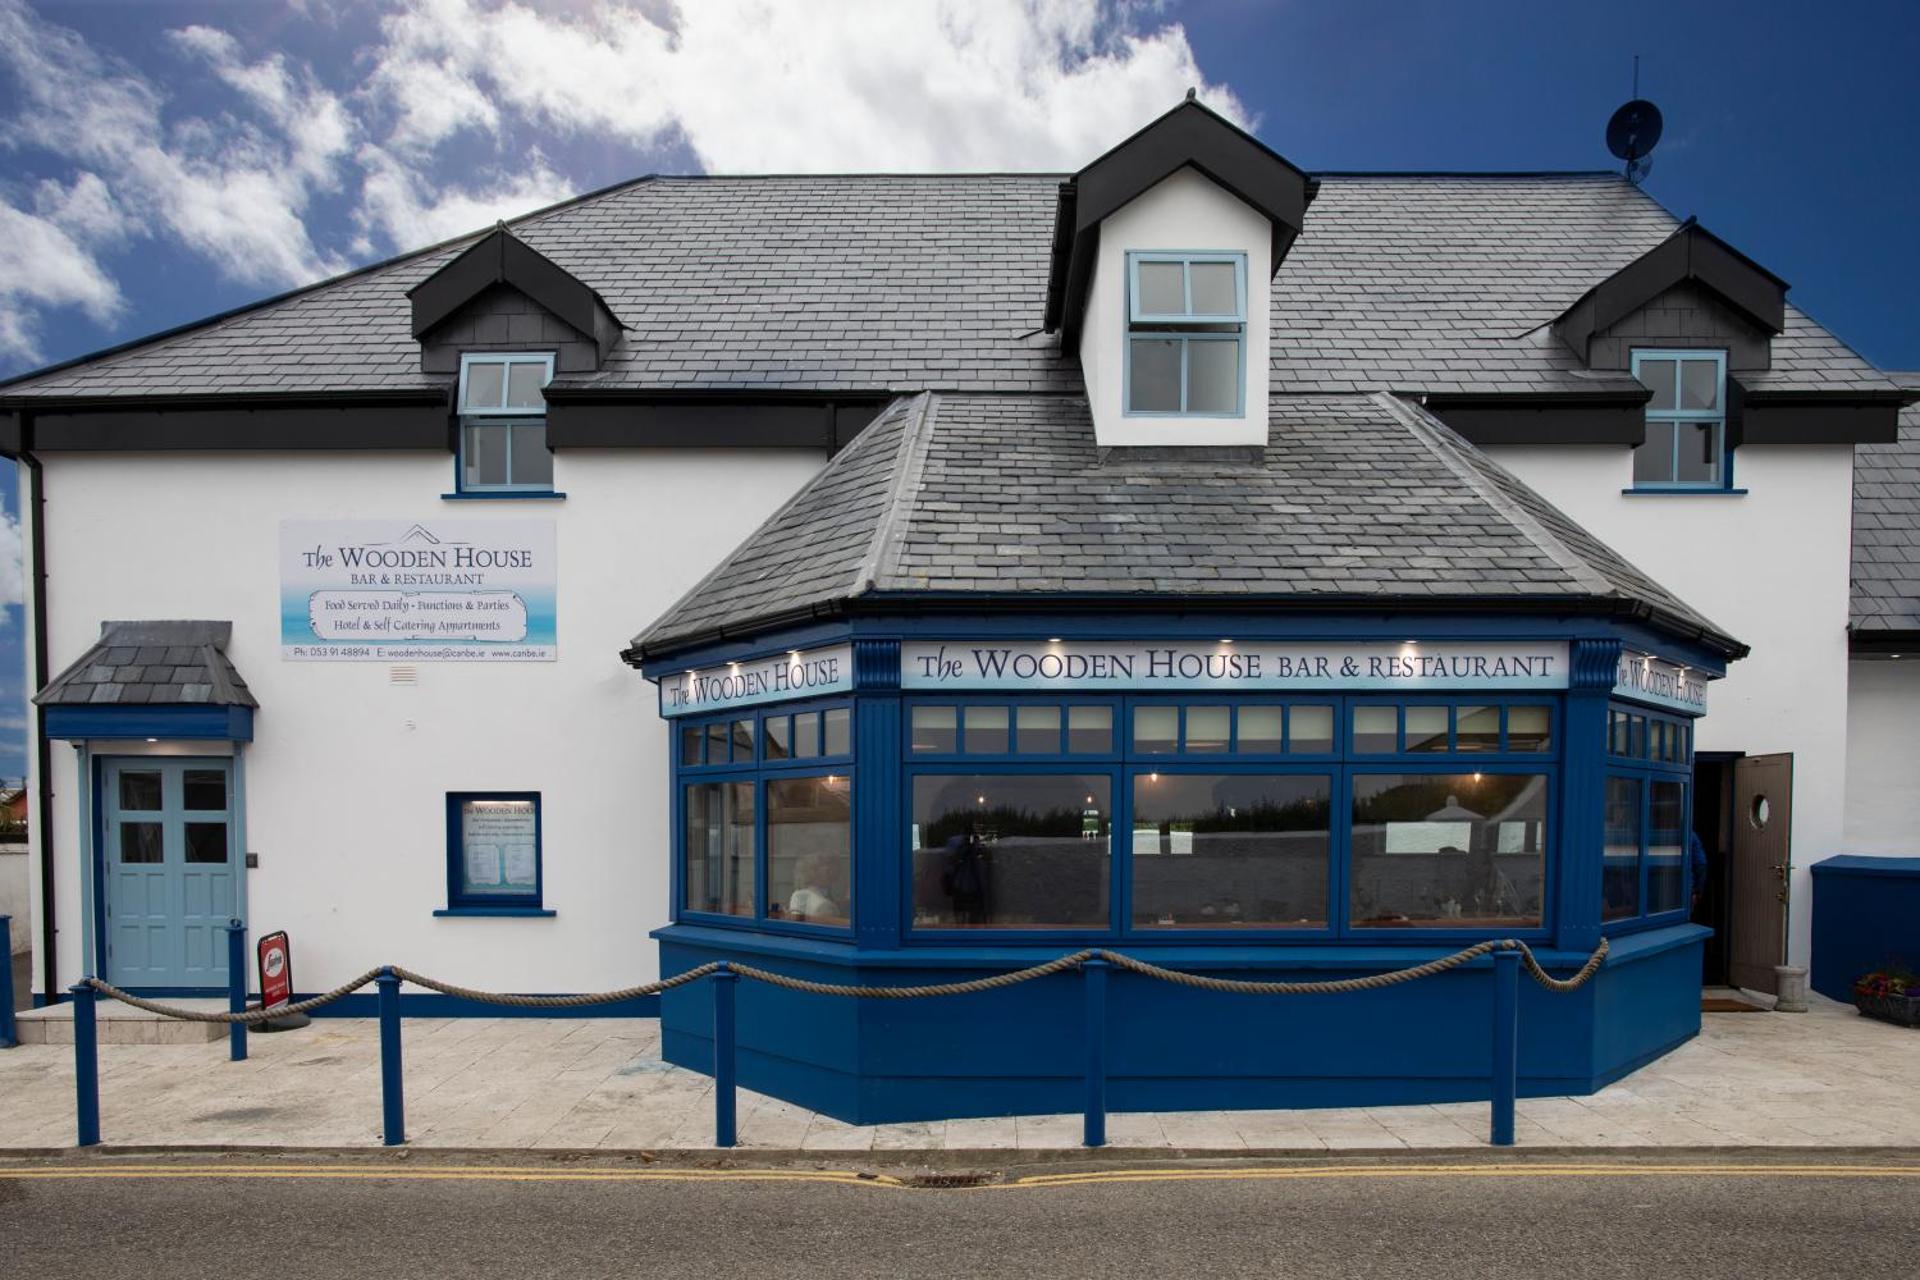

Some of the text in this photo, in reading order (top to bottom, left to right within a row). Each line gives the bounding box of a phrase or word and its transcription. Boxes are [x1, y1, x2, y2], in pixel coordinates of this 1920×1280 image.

[303, 544, 532, 570] The WOODEN HOUSE
[351, 573, 485, 585] BAR & RESTAURANT
[325, 600, 345, 610] Food
[348, 600, 380, 610] Served
[383, 598, 409, 613] Daily
[418, 600, 463, 611] Functions
[465, 601, 474, 610] &
[477, 600, 510, 610] Parties
[334, 617, 360, 630] Hotel
[363, 620, 372, 630] &
[374, 617, 392, 632] Self
[393, 620, 435, 633] Catering
[311, 647, 327, 656] 053
[917, 646, 1554, 682] The WOODEN HOUSE BAR & RESTAURANT
[670, 658, 839, 708] The WOODEN HOUSE
[1630, 660, 1674, 698] WOODEN
[1676, 674, 1703, 706] HOUSE
